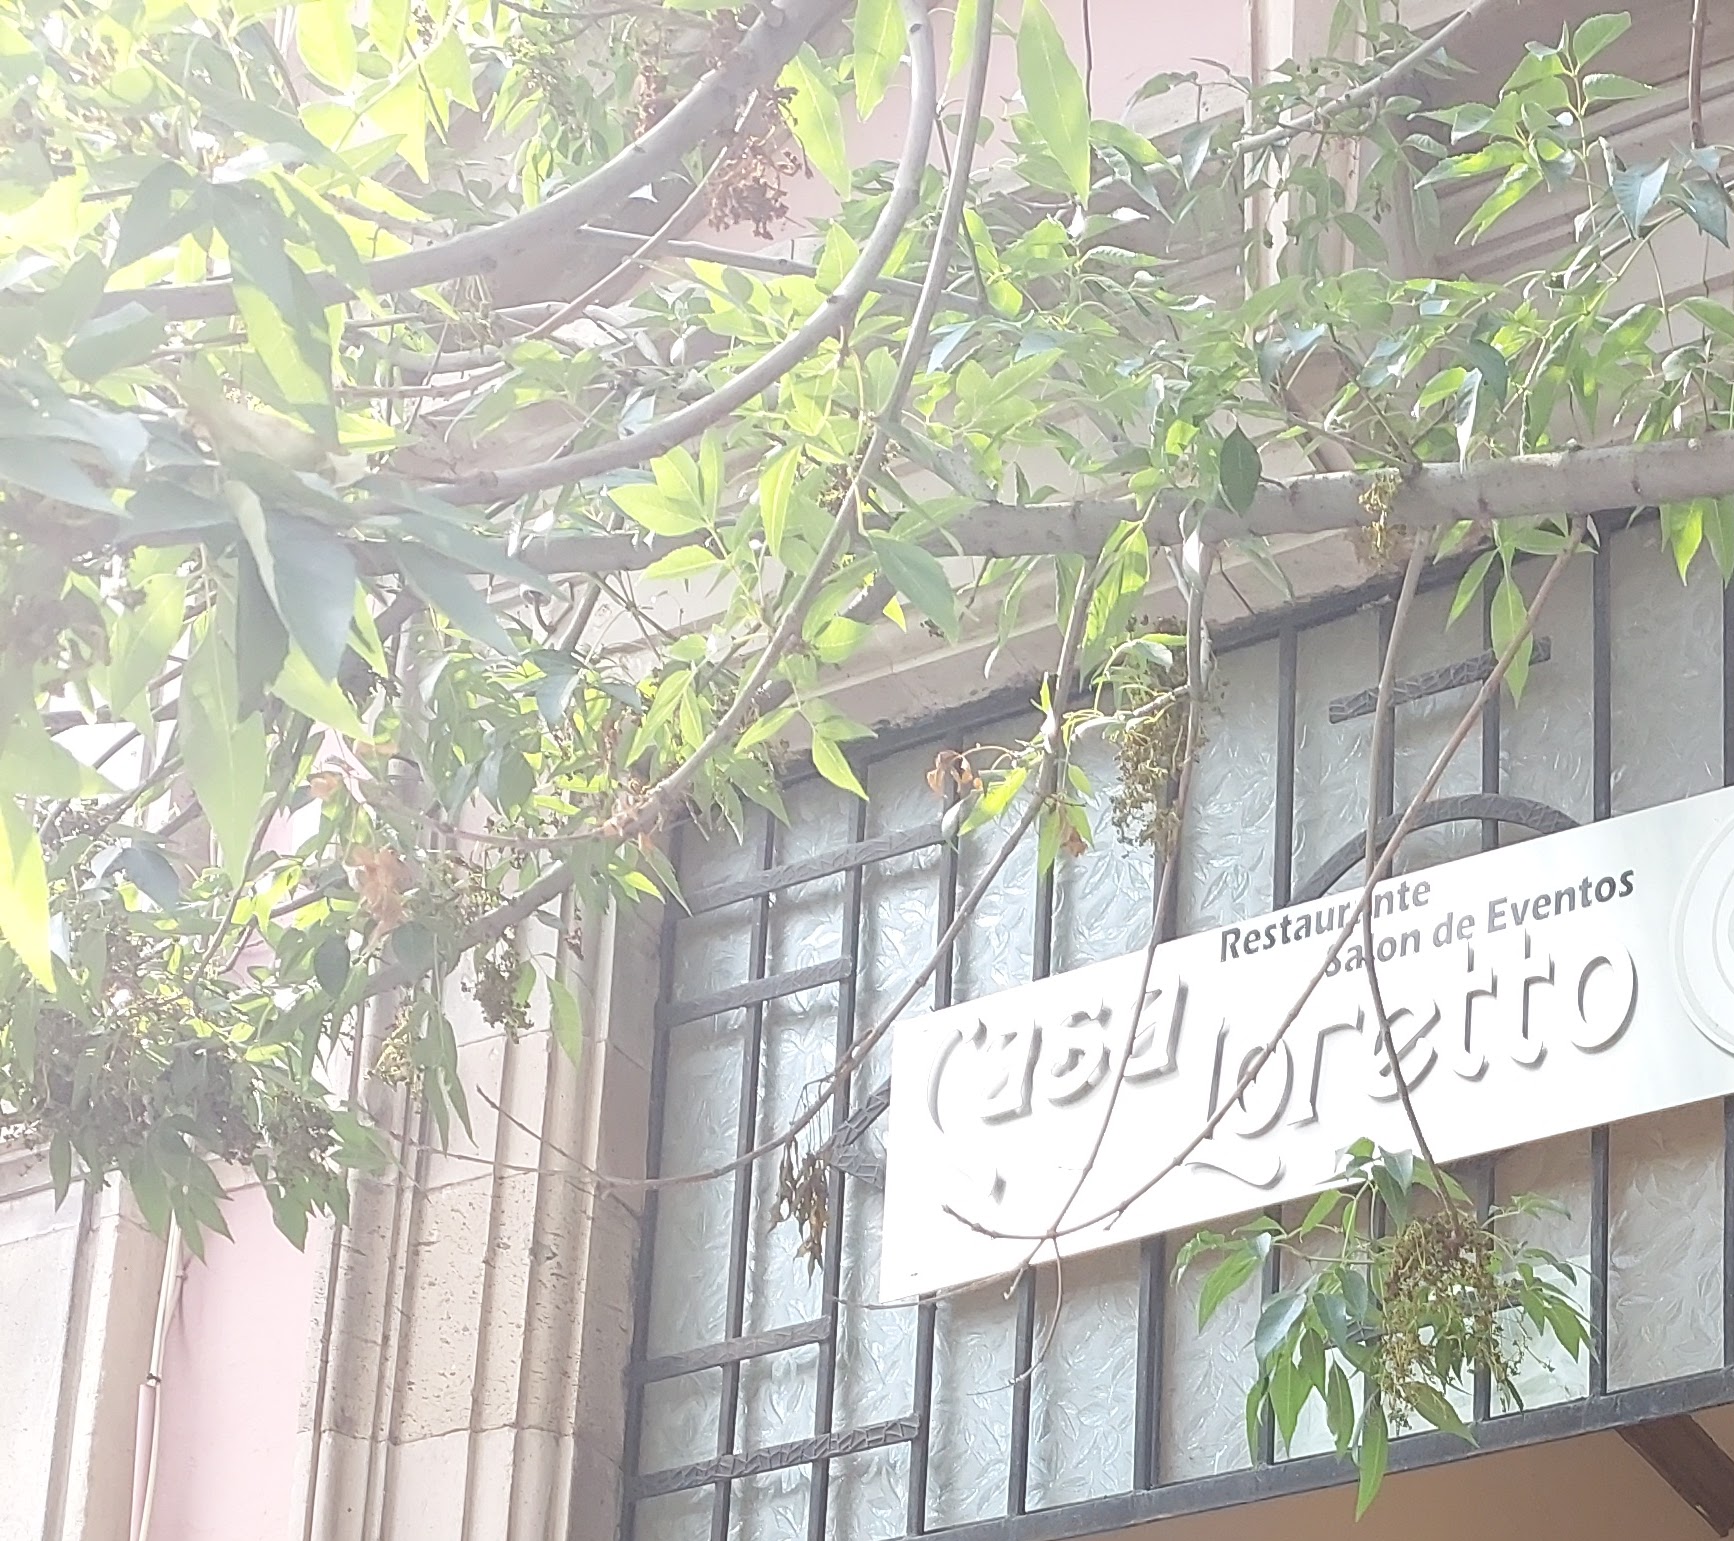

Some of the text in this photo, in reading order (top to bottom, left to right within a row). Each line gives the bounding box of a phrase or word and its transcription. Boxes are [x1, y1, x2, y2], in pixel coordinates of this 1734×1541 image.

[1219, 880, 1431, 962] Restaurnte
[1324, 869, 1635, 978] Saon de Eventos
